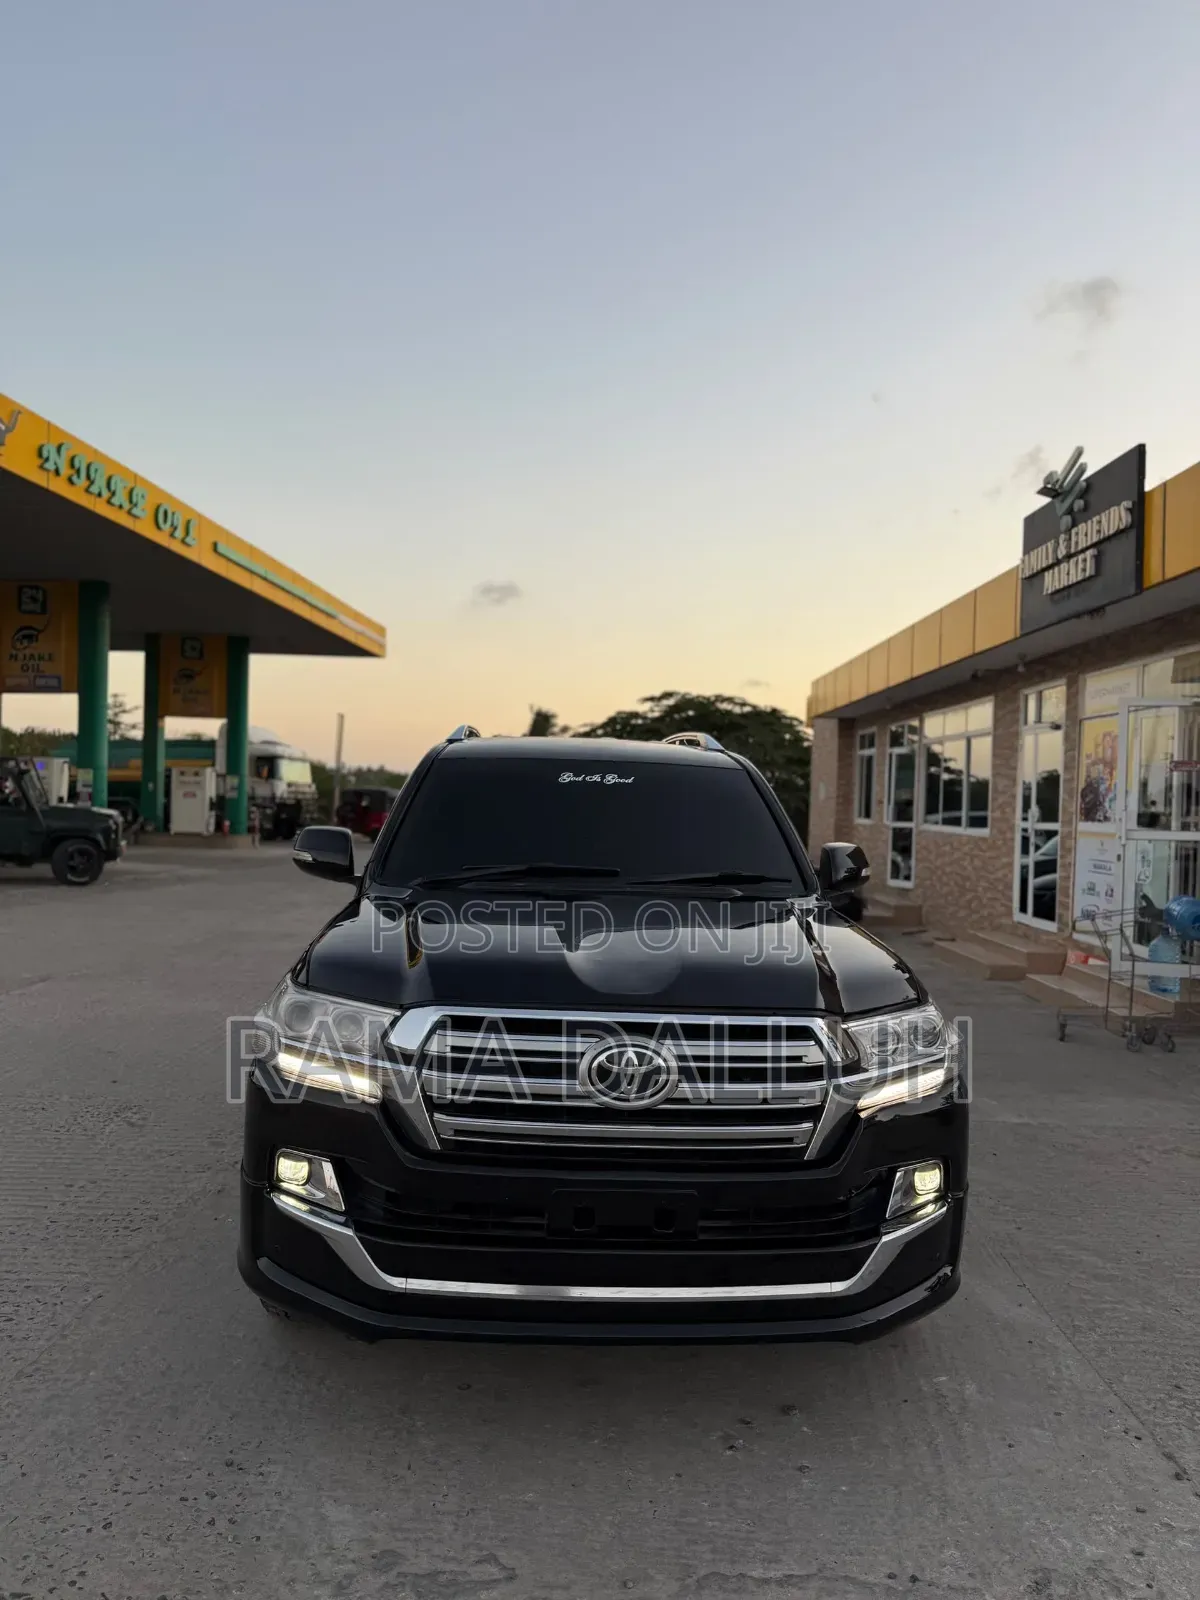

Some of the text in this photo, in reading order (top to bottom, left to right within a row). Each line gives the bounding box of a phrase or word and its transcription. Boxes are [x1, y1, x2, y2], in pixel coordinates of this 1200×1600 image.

[155, 503, 197, 547] OIL
[1057, 532, 1071, 560] &
[1071, 500, 1133, 552] FRIENDS
[1043, 548, 1099, 595] MARKET
[558, 772, 585, 783] God
[603, 773, 635, 785] Good
